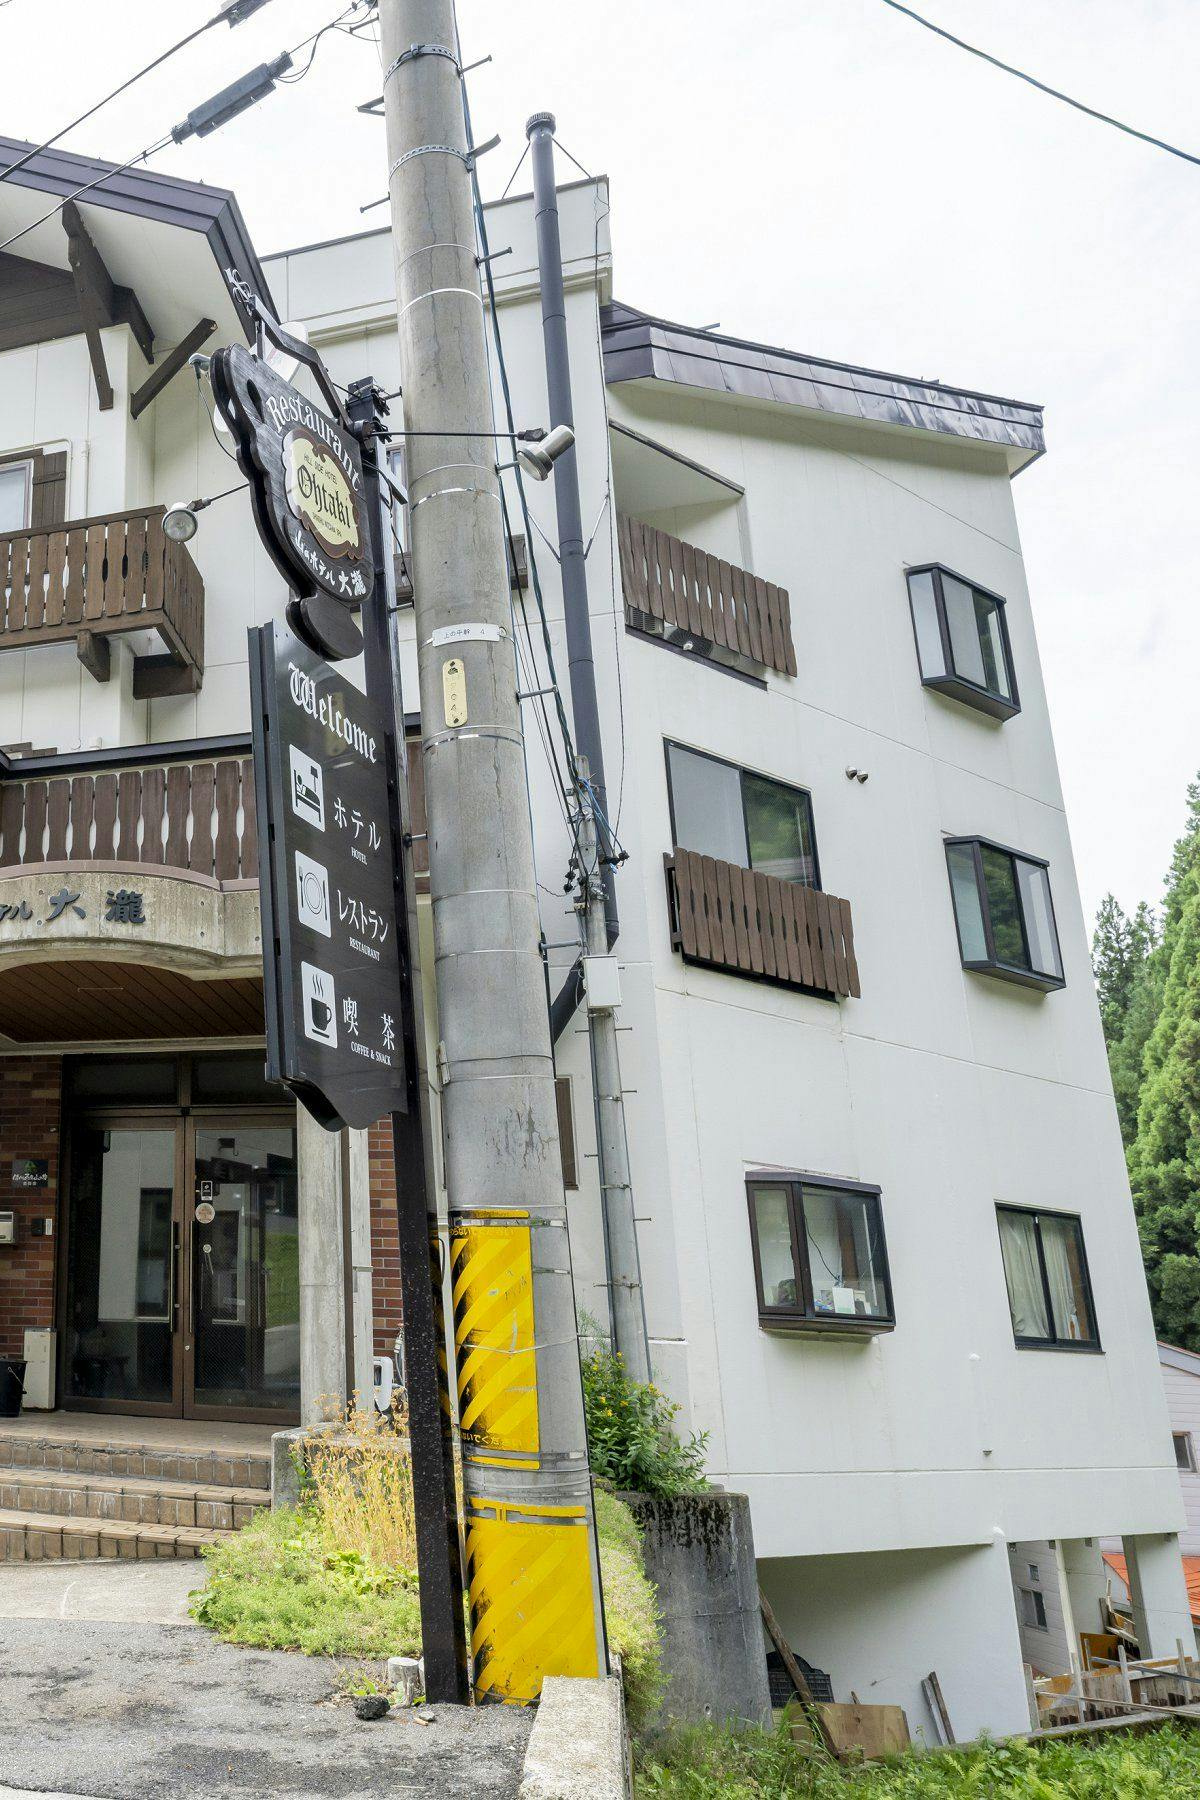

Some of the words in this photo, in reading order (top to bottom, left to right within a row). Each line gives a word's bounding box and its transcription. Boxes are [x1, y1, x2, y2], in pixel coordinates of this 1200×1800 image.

[266, 395, 360, 492] Restaurant
[297, 464, 351, 529] Ohtaki
[288, 662, 377, 764] Welcome
[333, 797, 382, 851] ホテル
[351, 846, 368, 866] HOTEL
[337, 889, 389, 943] レストラン
[349, 936, 380, 962] RESTAURANT
[343, 997, 395, 1050] 喫茶
[351, 1041, 370, 1058] COFFEE
[375, 1051, 392, 1066] SNACK
